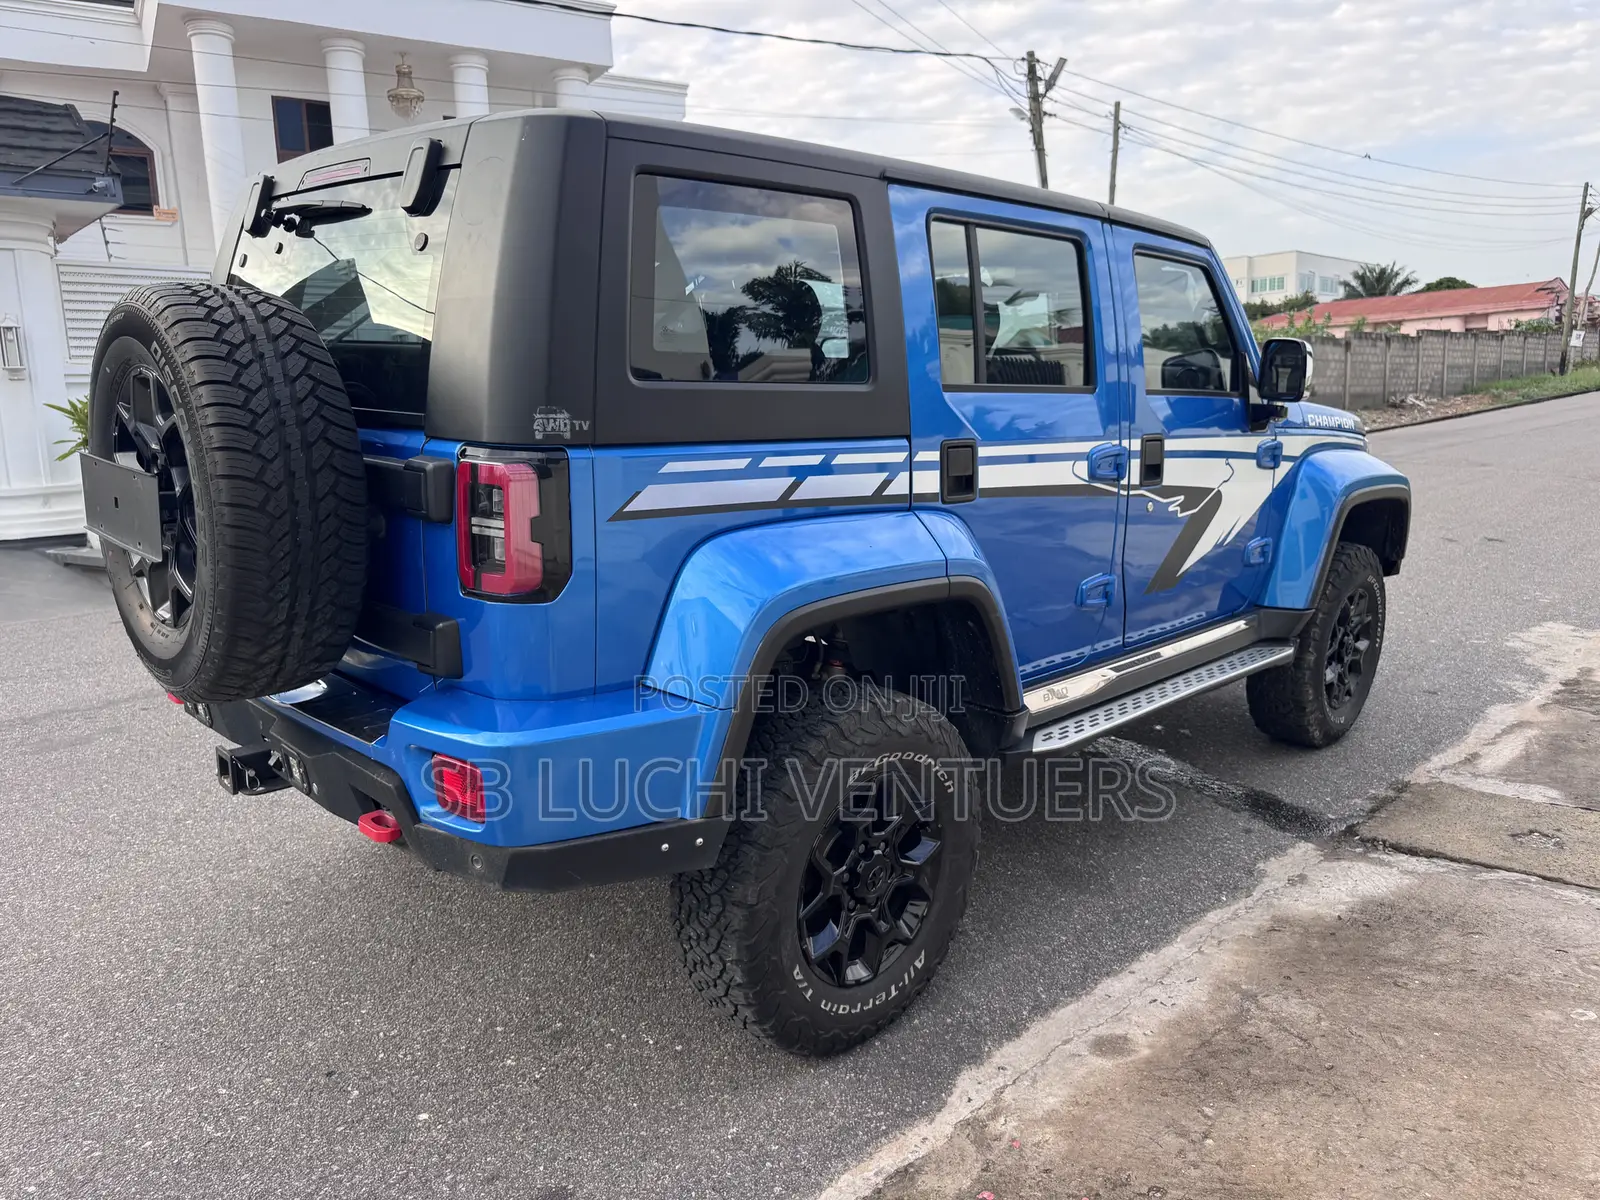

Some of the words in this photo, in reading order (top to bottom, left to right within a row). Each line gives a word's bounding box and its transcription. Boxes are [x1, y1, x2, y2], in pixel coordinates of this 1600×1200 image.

[572, 420, 590, 431] TV
[1307, 414, 1355, 430] CHAMPION
[846, 751, 955, 793] BFGoodrich
